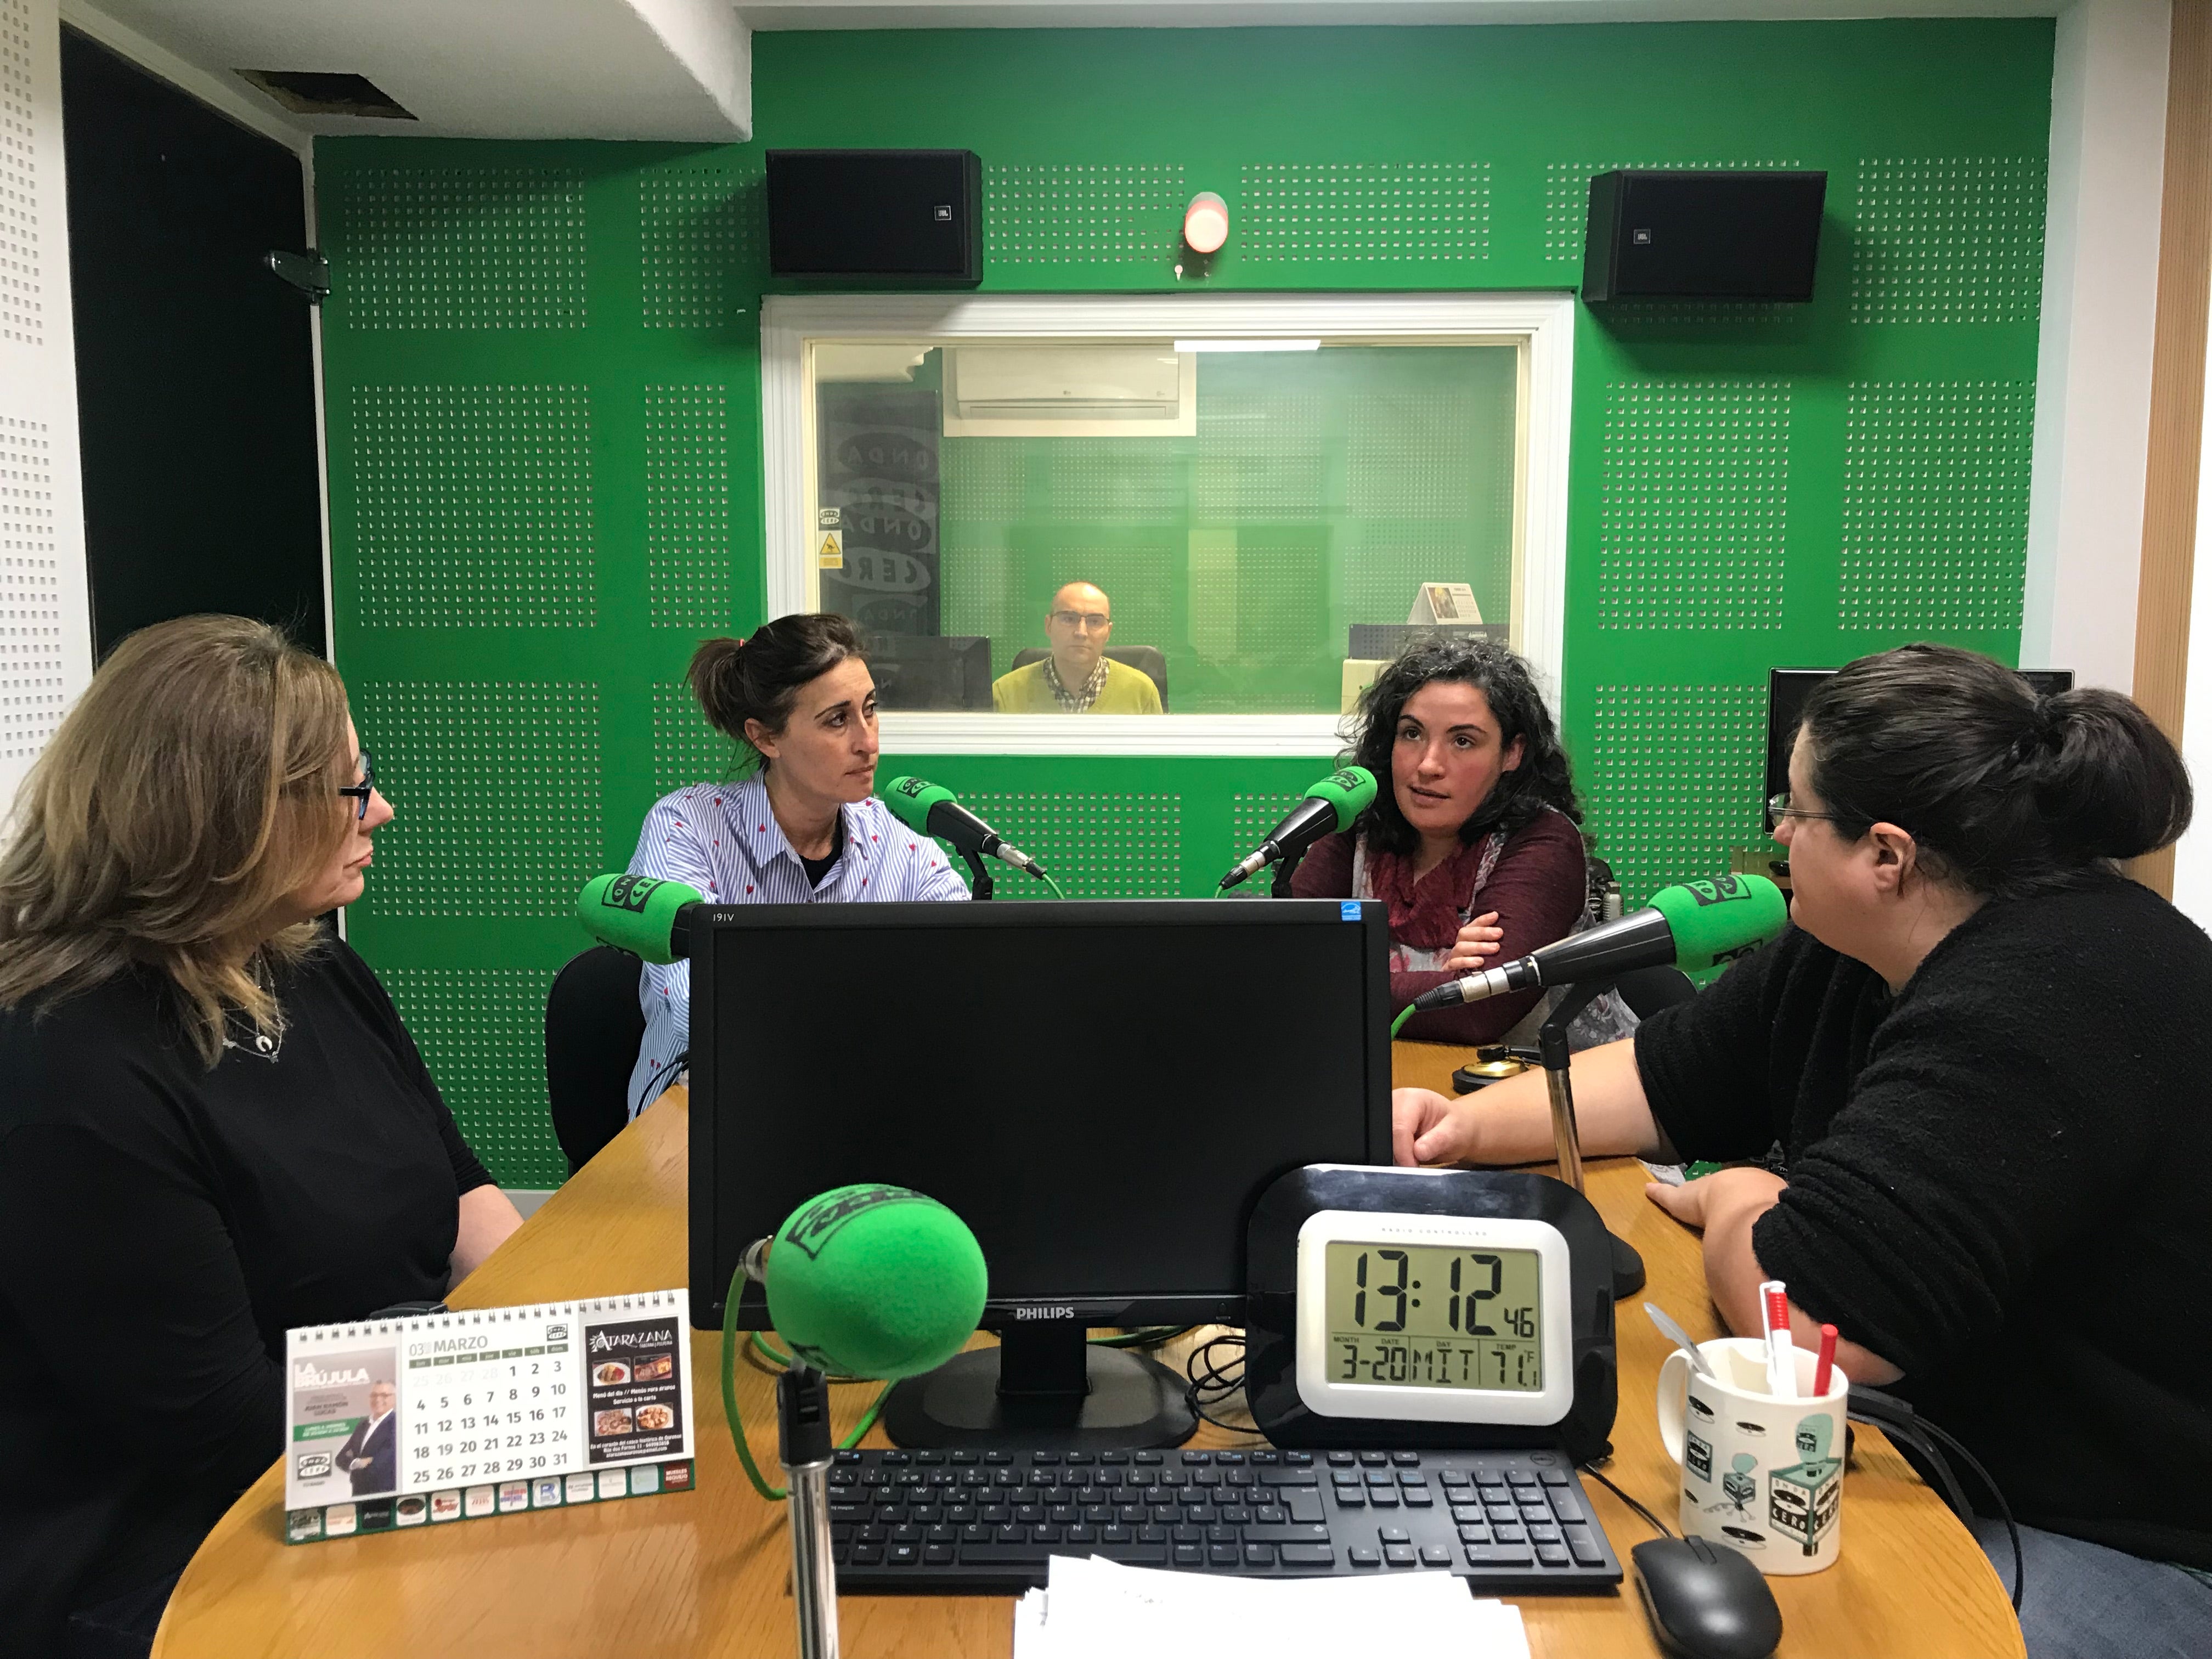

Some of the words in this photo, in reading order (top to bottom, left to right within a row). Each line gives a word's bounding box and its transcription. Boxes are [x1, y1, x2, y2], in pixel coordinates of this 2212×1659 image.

[1355, 1250, 1502, 1336] 13:12
[1504, 1307, 1534, 1338] 46
[1017, 1307, 1074, 1319] PHILIPS
[409, 1343, 424, 1357] 03
[433, 1335, 488, 1353] MARZO
[591, 1330, 673, 1353] ATARAZANA
[510, 1365, 516, 1376] 1
[532, 1363, 539, 1374] 2
[554, 1361, 561, 1372] 3
[1342, 1345, 1407, 1381] 3-20
[1413, 1349, 1475, 1383] MIT
[295, 1368, 370, 1389] BRÚJULA
[417, 1400, 426, 1410] 4
[441, 1396, 449, 1408] 5
[464, 1393, 472, 1406] 6
[487, 1391, 494, 1403] 7
[509, 1389, 518, 1401] 8
[532, 1386, 540, 1397] 9
[551, 1383, 566, 1395] 10
[415, 1423, 428, 1435] 11
[437, 1419, 453, 1432] 12
[461, 1417, 476, 1429] 13
[483, 1414, 499, 1426] 14
[506, 1411, 521, 1424] 15
[529, 1409, 544, 1421] 16
[552, 1406, 566, 1418] 17
[414, 1446, 430, 1459] 18
[437, 1443, 453, 1455] 19
[460, 1440, 477, 1453] 20
[484, 1438, 498, 1451] 21
[506, 1435, 522, 1447] 22
[529, 1432, 545, 1444] 23
[552, 1430, 567, 1442] 24
[413, 1470, 430, 1483] 25
[437, 1467, 454, 1480] 26
[461, 1464, 476, 1477] 27
[483, 1462, 500, 1475] 28
[507, 1458, 523, 1471] 29
[529, 1455, 546, 1469] 30
[553, 1453, 567, 1466] 31
[1773, 1508, 1805, 1530] CERO
